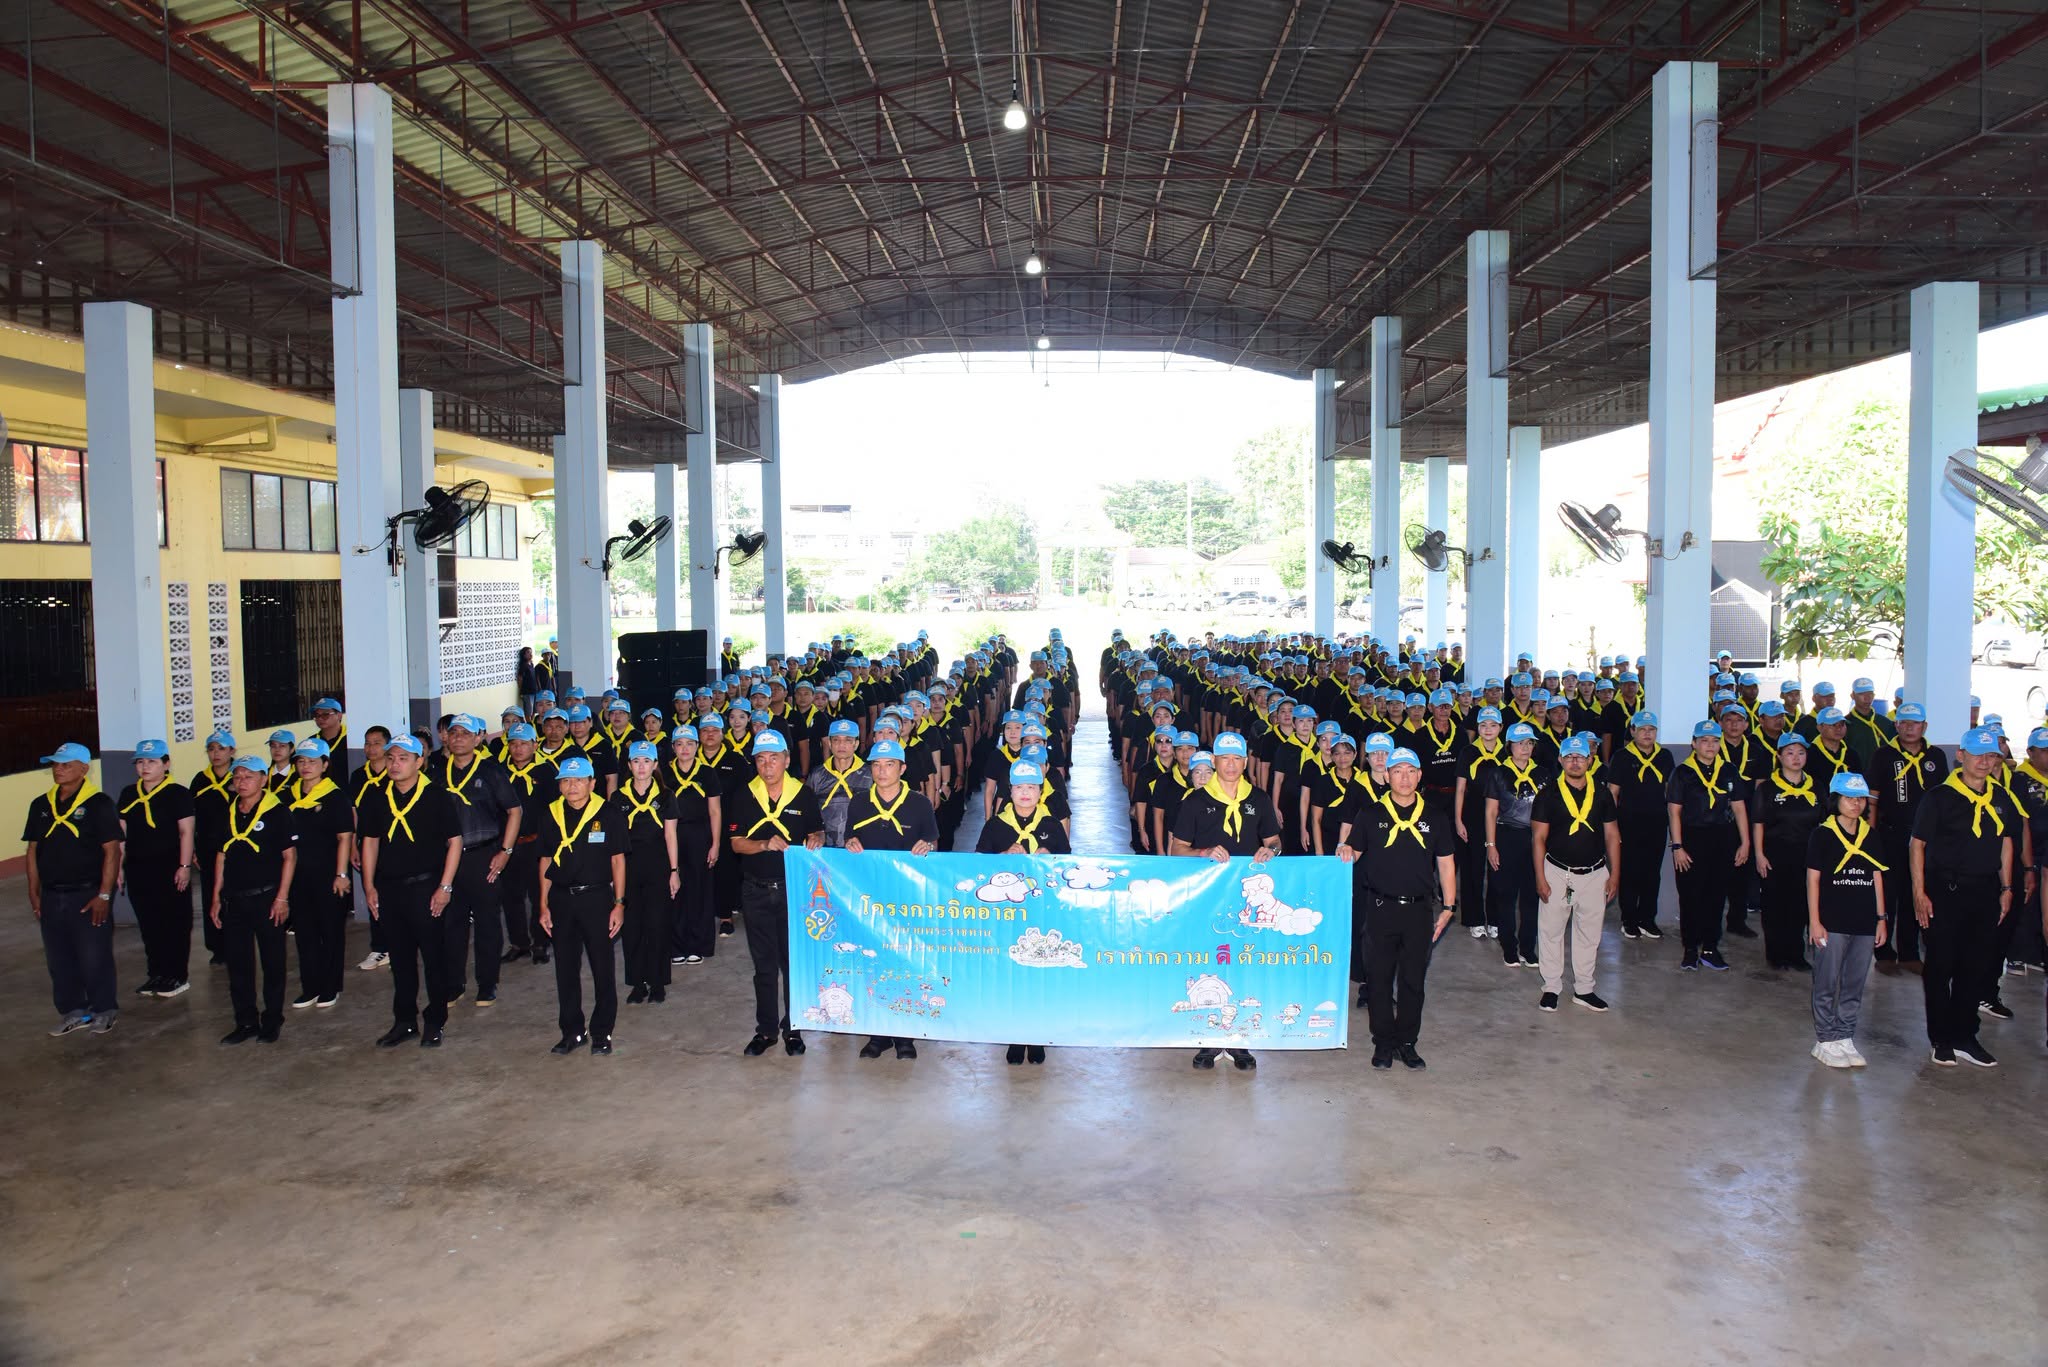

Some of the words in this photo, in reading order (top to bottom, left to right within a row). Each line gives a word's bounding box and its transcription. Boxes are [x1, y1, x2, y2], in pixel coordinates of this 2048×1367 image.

[859, 894, 1028, 922] โครงการจิตอาสา
[1096, 946, 1209, 965] เราทำความ
[1216, 944, 1231, 965] ดี
[1238, 944, 1333, 965] ด้วยหัวใจ
